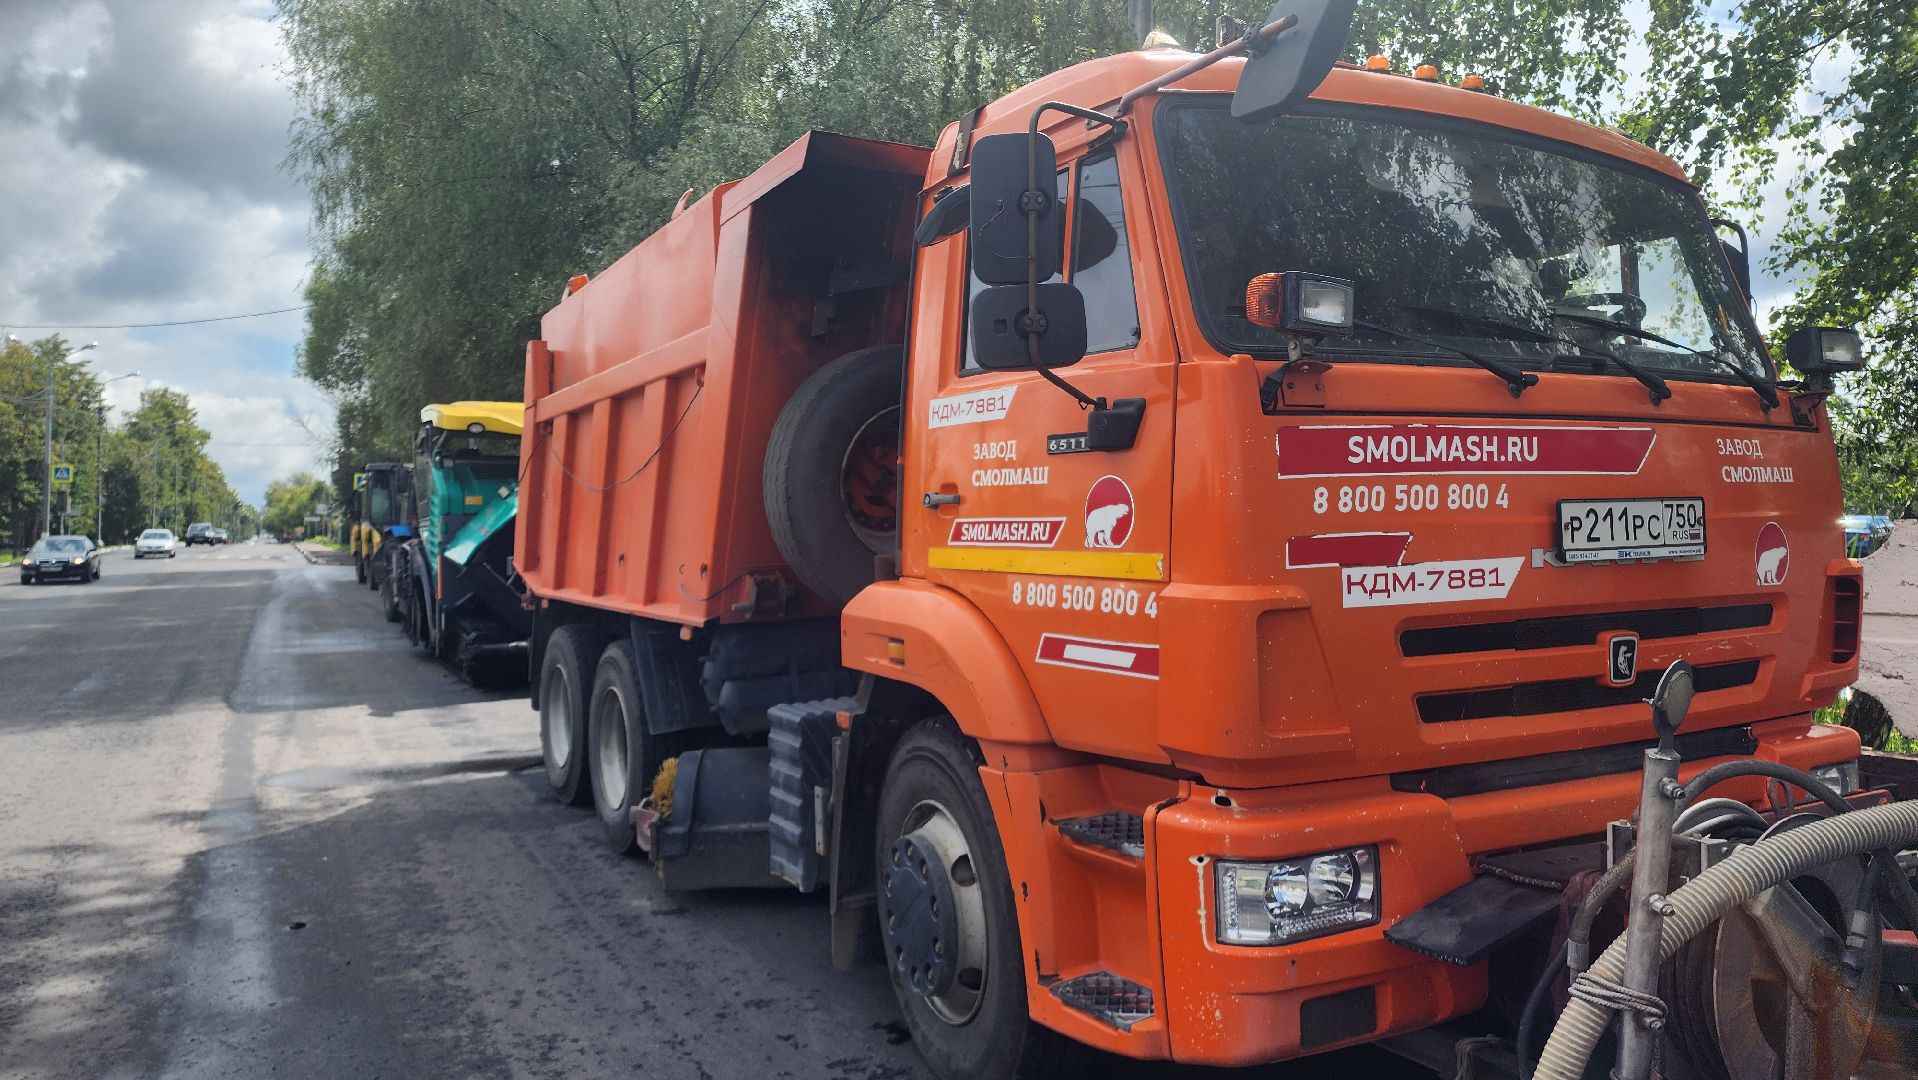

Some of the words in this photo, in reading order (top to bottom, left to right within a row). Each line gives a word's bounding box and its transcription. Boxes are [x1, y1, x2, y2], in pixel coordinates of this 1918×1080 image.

[931, 395, 1007, 423] КДМ-7881
[973, 440, 1017, 461] ЗАВОД
[1347, 435, 1538, 463] SMOLMASH.RU
[1716, 438, 1763, 459] ЗАВОД
[971, 466, 1049, 487] СМОЛМАШ
[1721, 466, 1795, 483] СМОЛМАШ
[1313, 486, 1329, 514] 8
[1338, 485, 1385, 513] 800
[1395, 484, 1438, 511] 500
[1447, 483, 1489, 509] 800
[1495, 483, 1509, 509] 4
[961, 522, 1050, 541] SMOLMASH.RU
[1570, 506, 1661, 543] Р211РС
[1663, 503, 1697, 530] 750
[1672, 529, 1689, 540] RUS
[1346, 566, 1506, 599] КДМ-7881
[1012, 581, 1022, 605] 8
[1026, 582, 1056, 608] 800
[1062, 585, 1095, 611] 500
[1100, 588, 1138, 616] 800
[1144, 592, 1158, 618] 4
